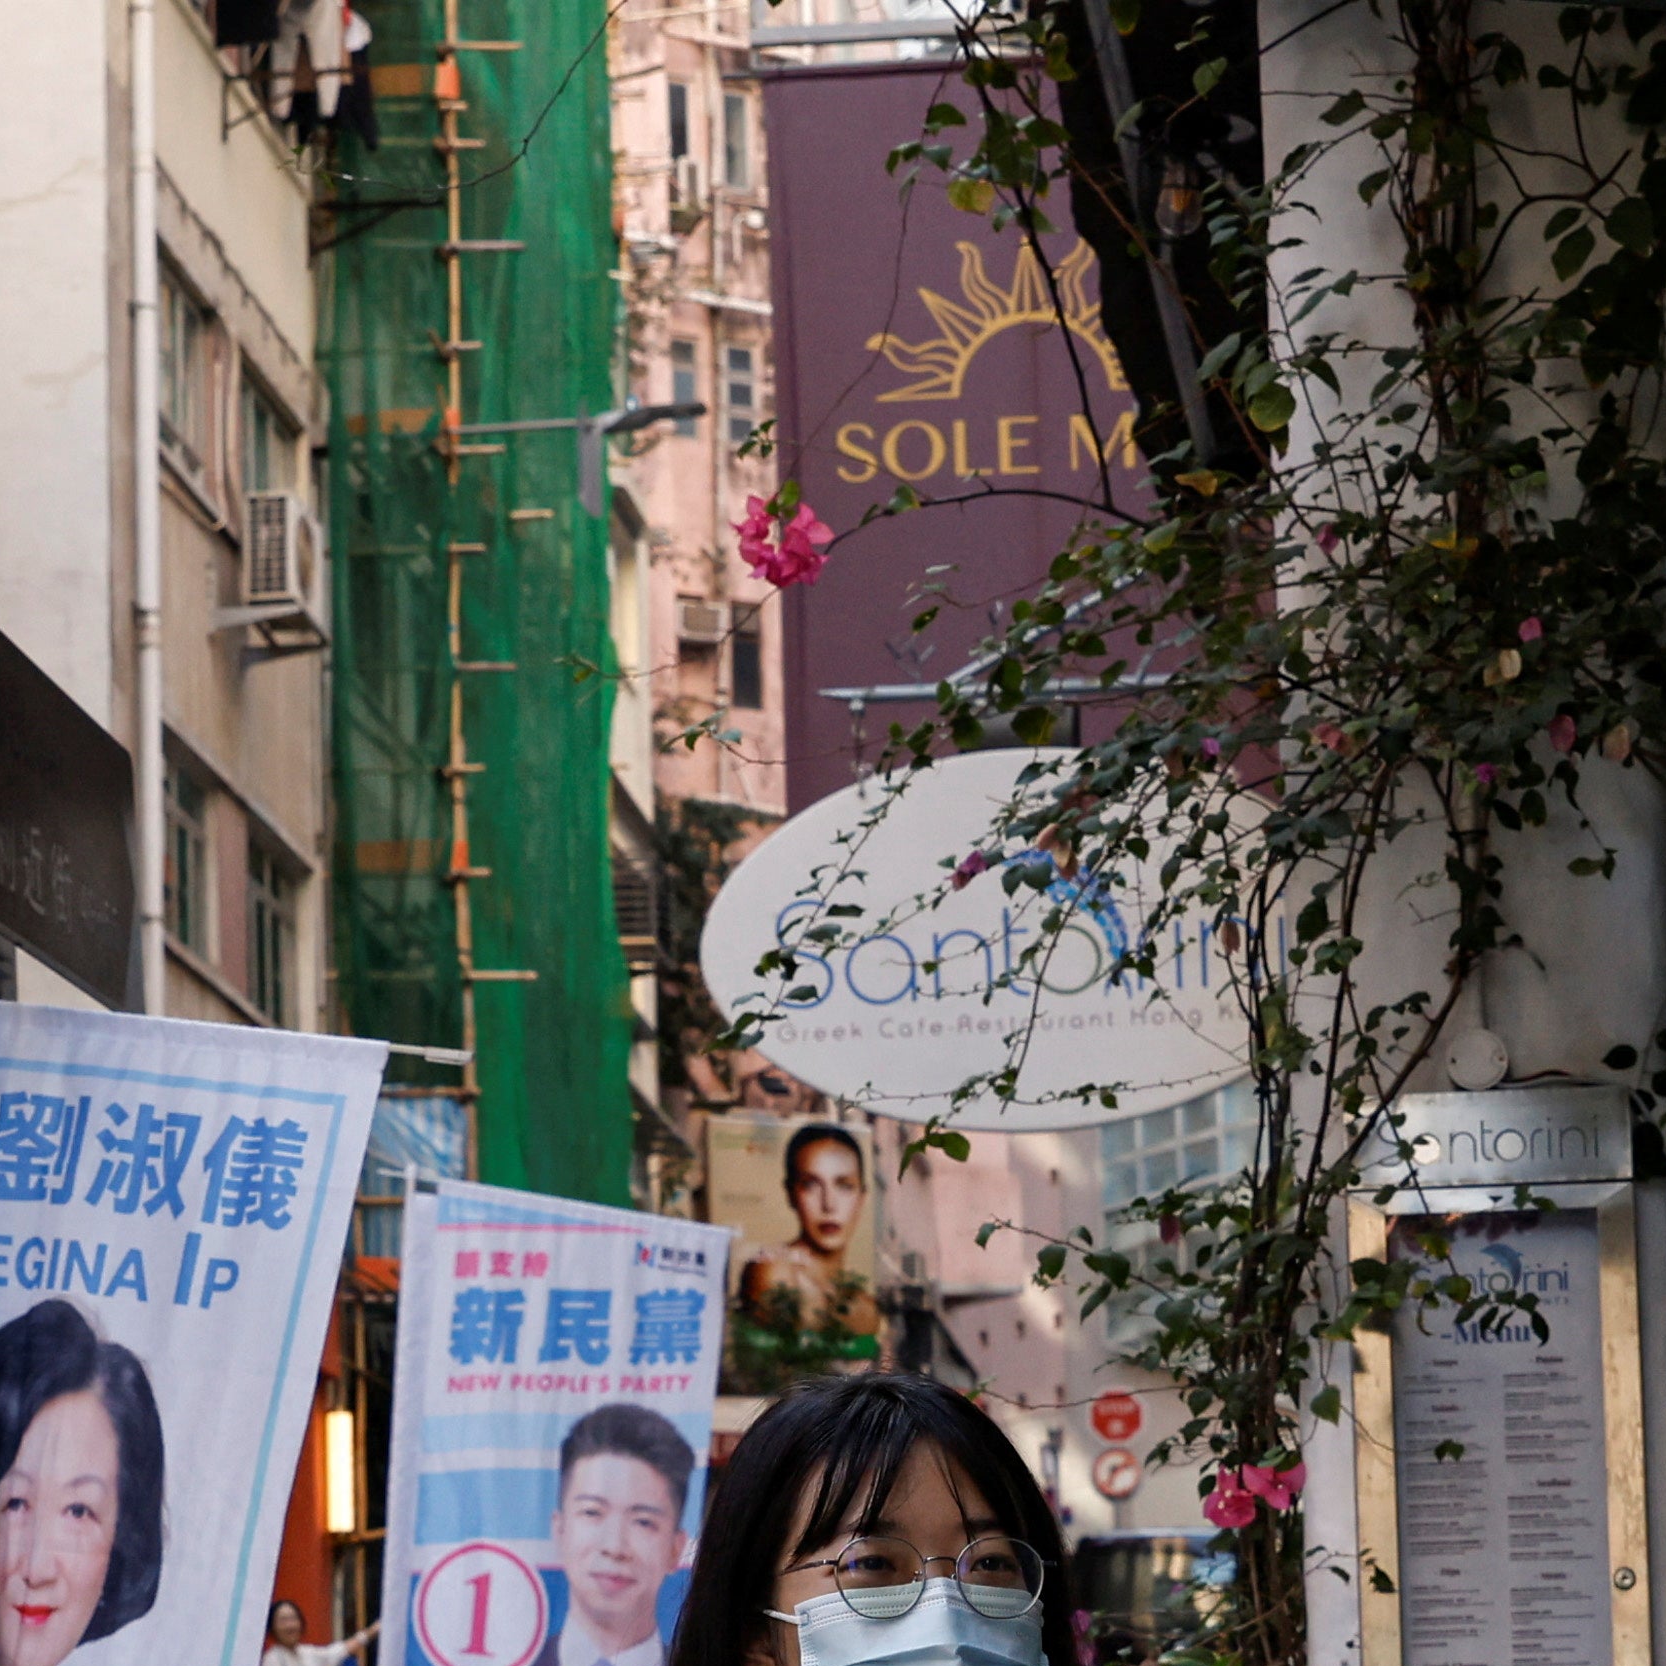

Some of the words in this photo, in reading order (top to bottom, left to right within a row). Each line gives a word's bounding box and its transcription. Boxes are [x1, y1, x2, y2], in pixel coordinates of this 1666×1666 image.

[836, 416, 1040, 483] SOLE
[1068, 411, 1136, 472] M
[776, 1024, 863, 1045] Greek
[1130, 1006, 1203, 1030] Hong
[448, 1287, 707, 1366] 新民黨
[446, 1375, 502, 1393] NEW
[510, 1374, 612, 1393] PEOPLE'S
[619, 1374, 693, 1393] PARTY
[459, 1573, 497, 1658] 1
